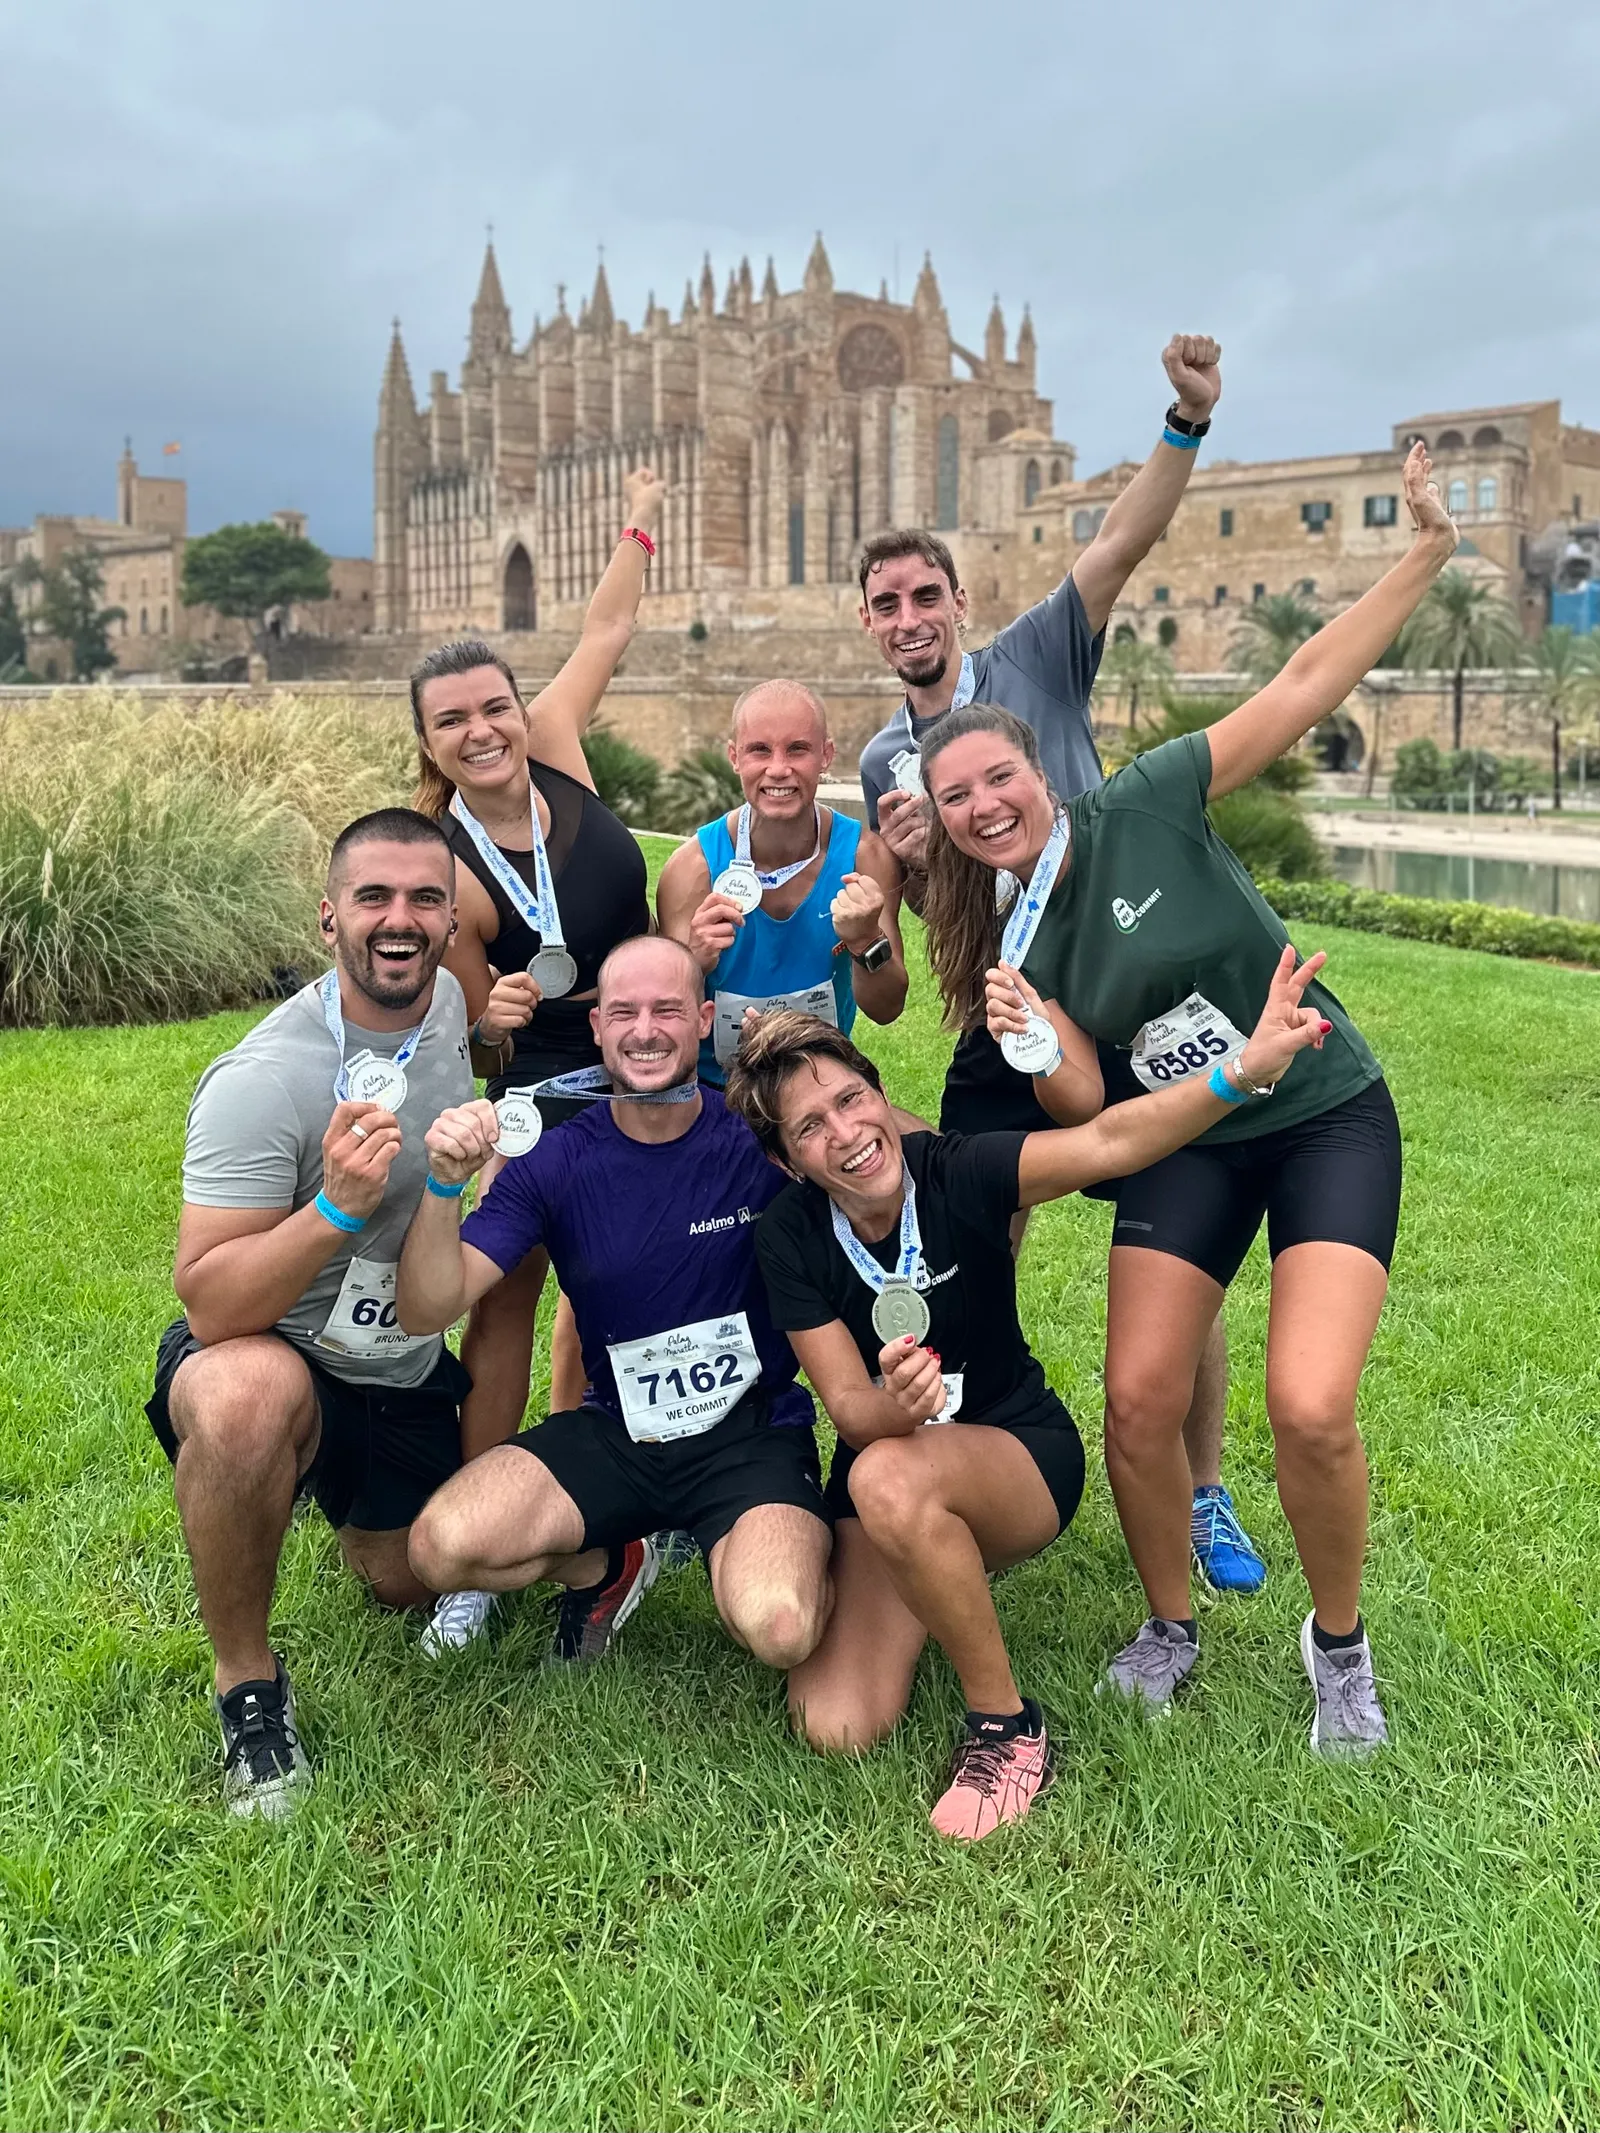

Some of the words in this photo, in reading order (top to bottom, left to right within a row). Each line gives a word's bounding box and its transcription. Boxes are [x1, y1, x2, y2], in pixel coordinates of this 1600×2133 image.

[723, 885, 753, 898] Marathon
[1135, 888, 1162, 918] COMMIT
[1013, 1038, 1048, 1054] Marathon
[1149, 1027, 1177, 1045] Marathon
[1145, 1028, 1229, 1081] 6585
[362, 1078, 396, 1101] Marathon
[689, 1215, 736, 1236] Adalmo
[931, 1263, 959, 1287] COMMIT
[374, 1334, 410, 1344] BRUNO
[663, 1343, 700, 1357] Marathon
[637, 1353, 744, 1406] 7162
[666, 1409, 684, 1421] WE
[685, 1396, 729, 1416] COMMIT
